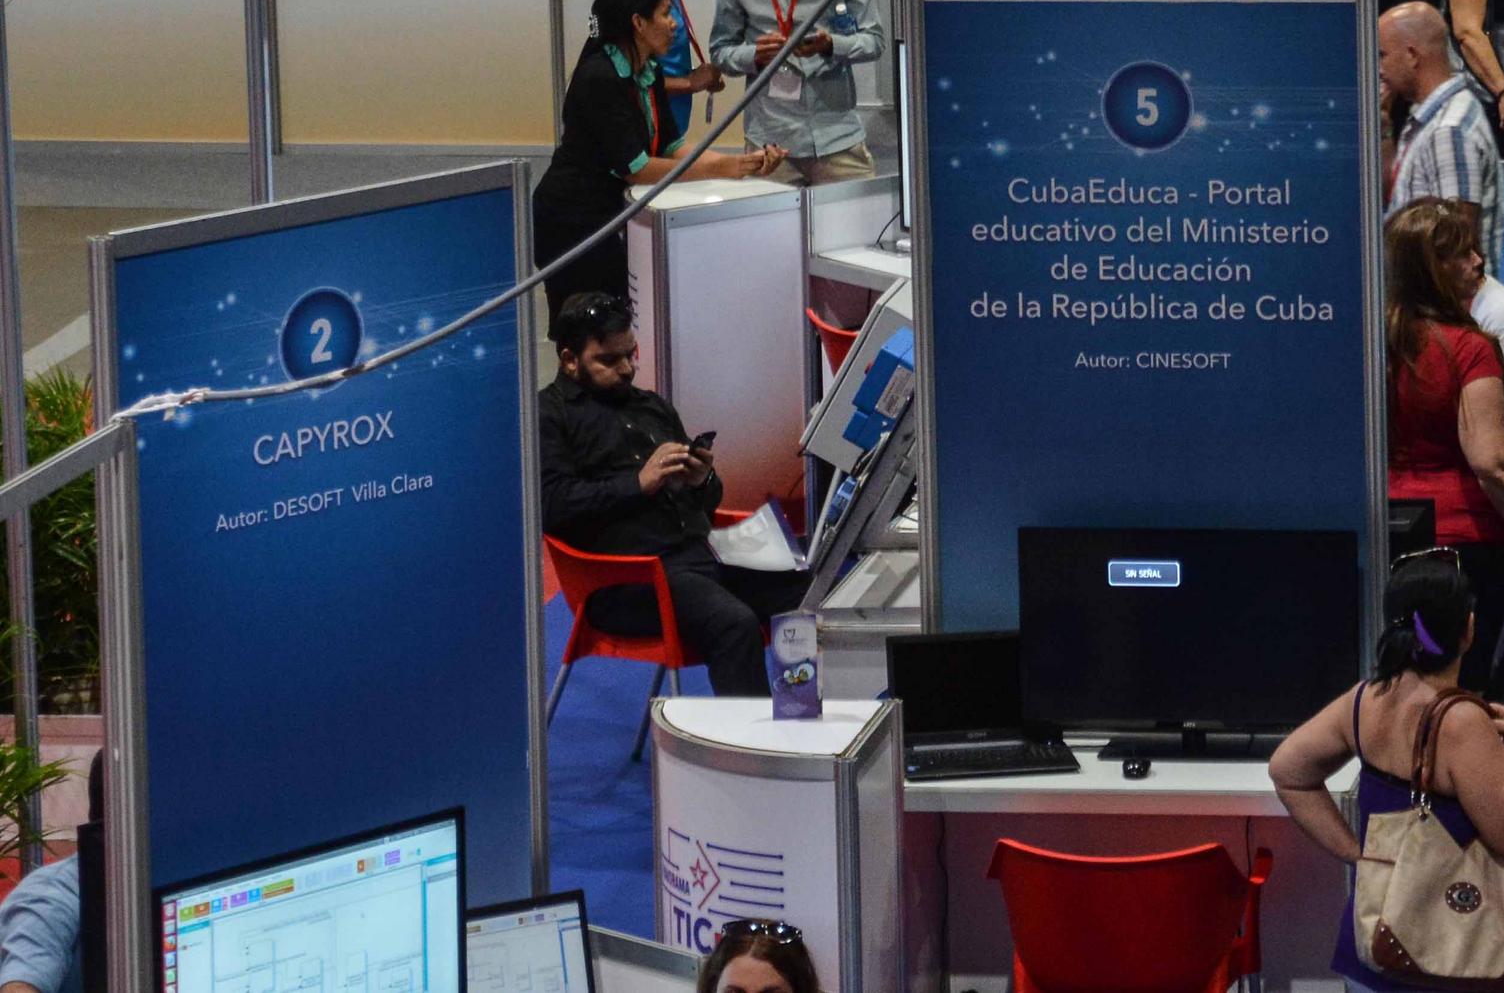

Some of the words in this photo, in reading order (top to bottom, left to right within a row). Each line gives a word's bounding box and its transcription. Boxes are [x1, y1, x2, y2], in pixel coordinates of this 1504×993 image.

[1135, 87, 1159, 127] 5
[1007, 176, 1179, 206] CubaEduca
[1207, 178, 1292, 206] Portal
[971, 215, 1117, 243] educativo
[1126, 216, 1173, 244] del
[1182, 217, 1330, 245] Ministerio
[1050, 254, 1089, 281] de
[1098, 253, 1252, 283] Educación
[969, 291, 1008, 319] de
[1017, 292, 1042, 319] la
[1051, 292, 1199, 326] República
[1207, 294, 1247, 321] de
[1255, 294, 1335, 321] Cuba
[309, 317, 334, 365] 2
[1074, 352, 1131, 370] Autor:
[1135, 351, 1232, 370] CINESOFT
[252, 410, 395, 467] CAPYROX
[215, 507, 270, 533] Autor:
[273, 488, 344, 521] DESOFT
[351, 479, 387, 503] Villa
[391, 472, 434, 496] Clara
[673, 905, 713, 955] TIC
